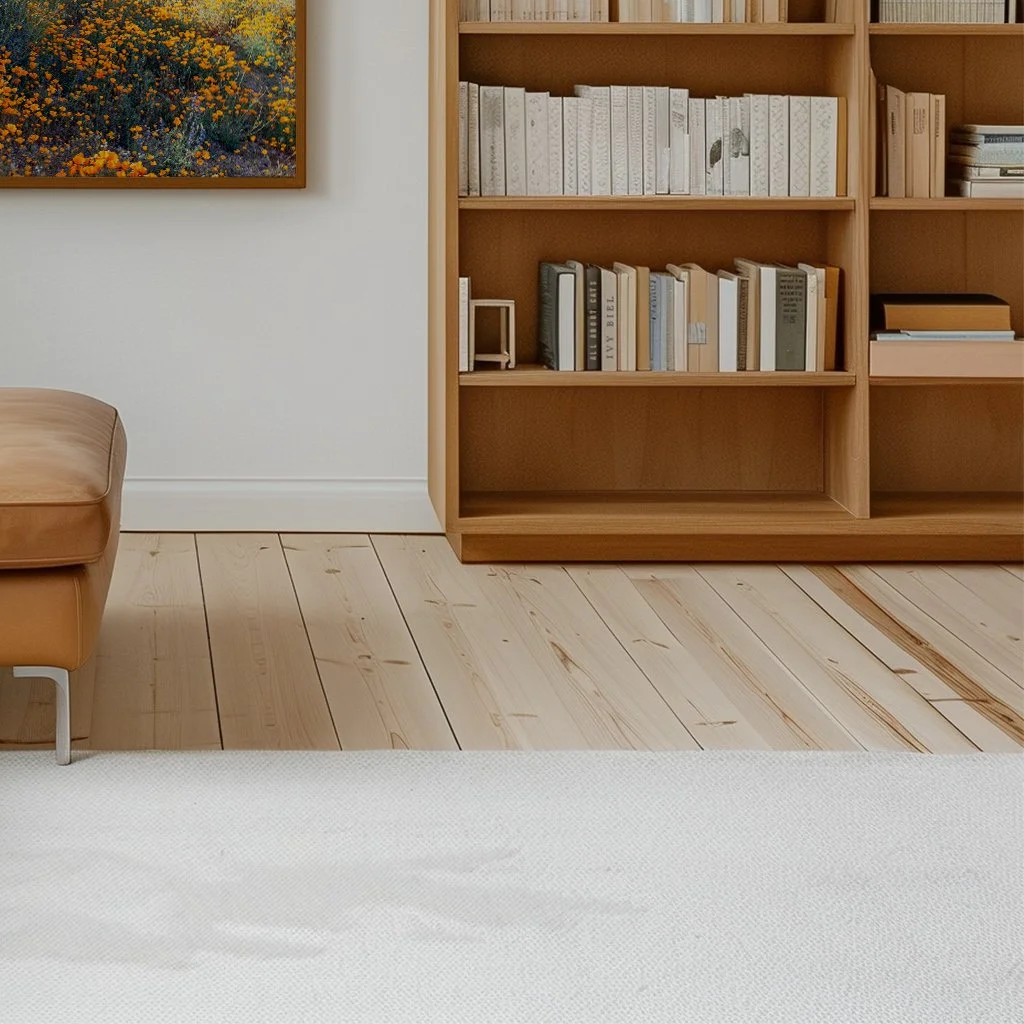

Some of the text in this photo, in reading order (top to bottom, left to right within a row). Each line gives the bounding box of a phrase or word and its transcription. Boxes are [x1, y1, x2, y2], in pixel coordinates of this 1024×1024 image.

[589, 281, 597, 361] ALL ABOUT CATS
[606, 296, 615, 359] IVY BIEL
